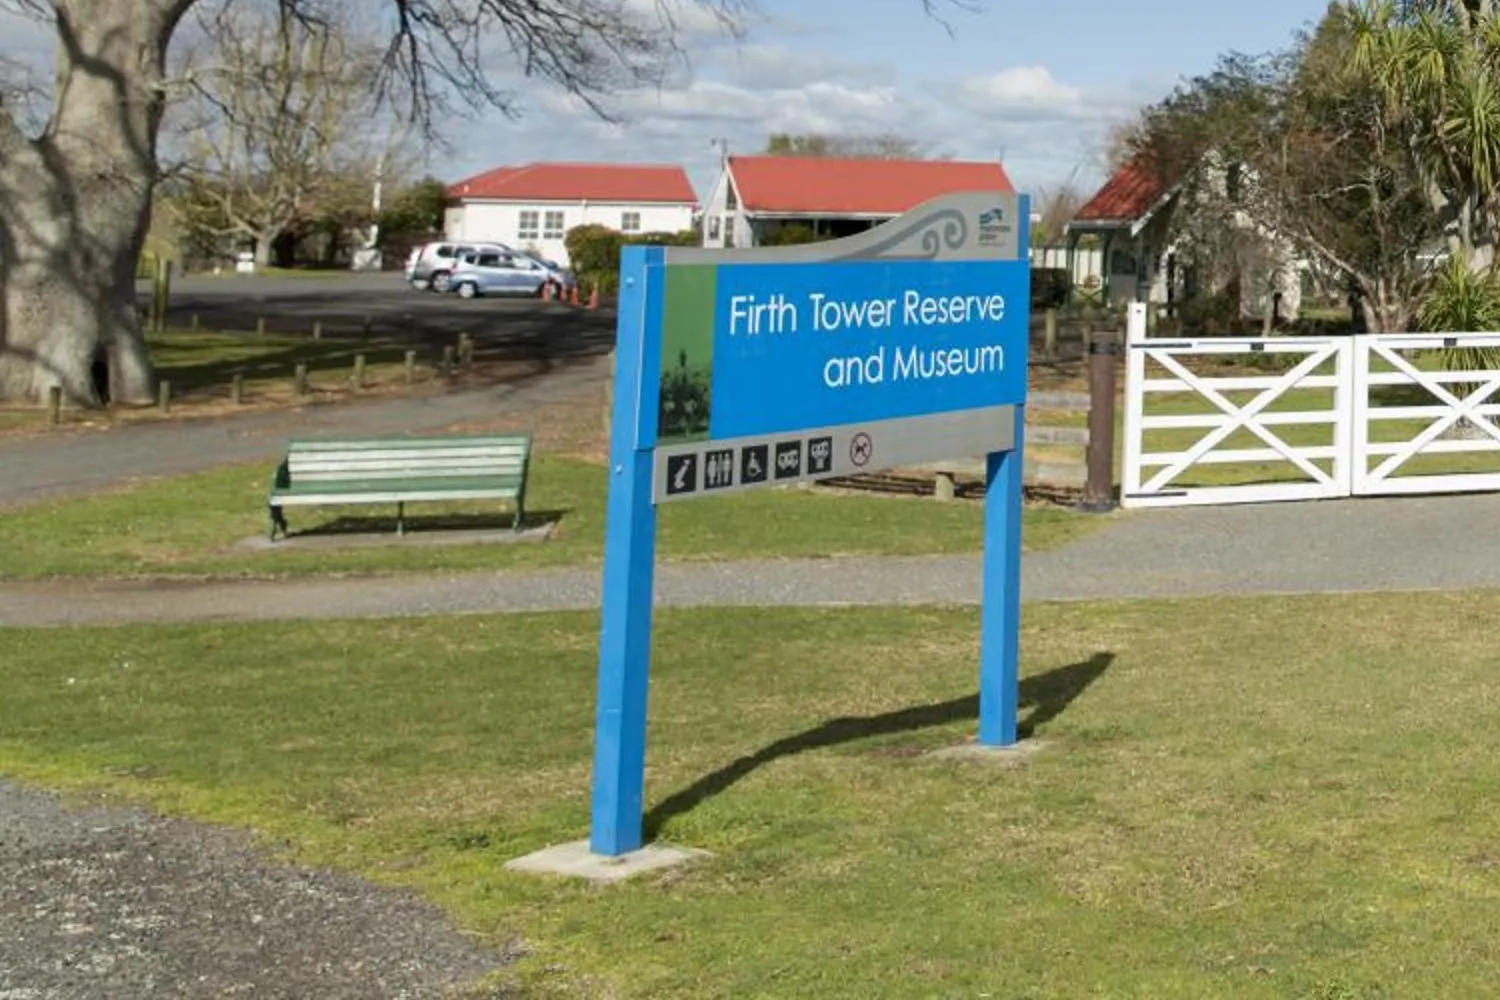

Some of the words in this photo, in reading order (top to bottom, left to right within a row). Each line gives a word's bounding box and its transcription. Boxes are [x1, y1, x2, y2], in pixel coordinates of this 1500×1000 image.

[729, 294, 798, 336] Firth
[809, 293, 897, 331] Tower
[903, 289, 1005, 326] Reserve
[823, 345, 885, 388] and
[892, 344, 1004, 381] Museum
